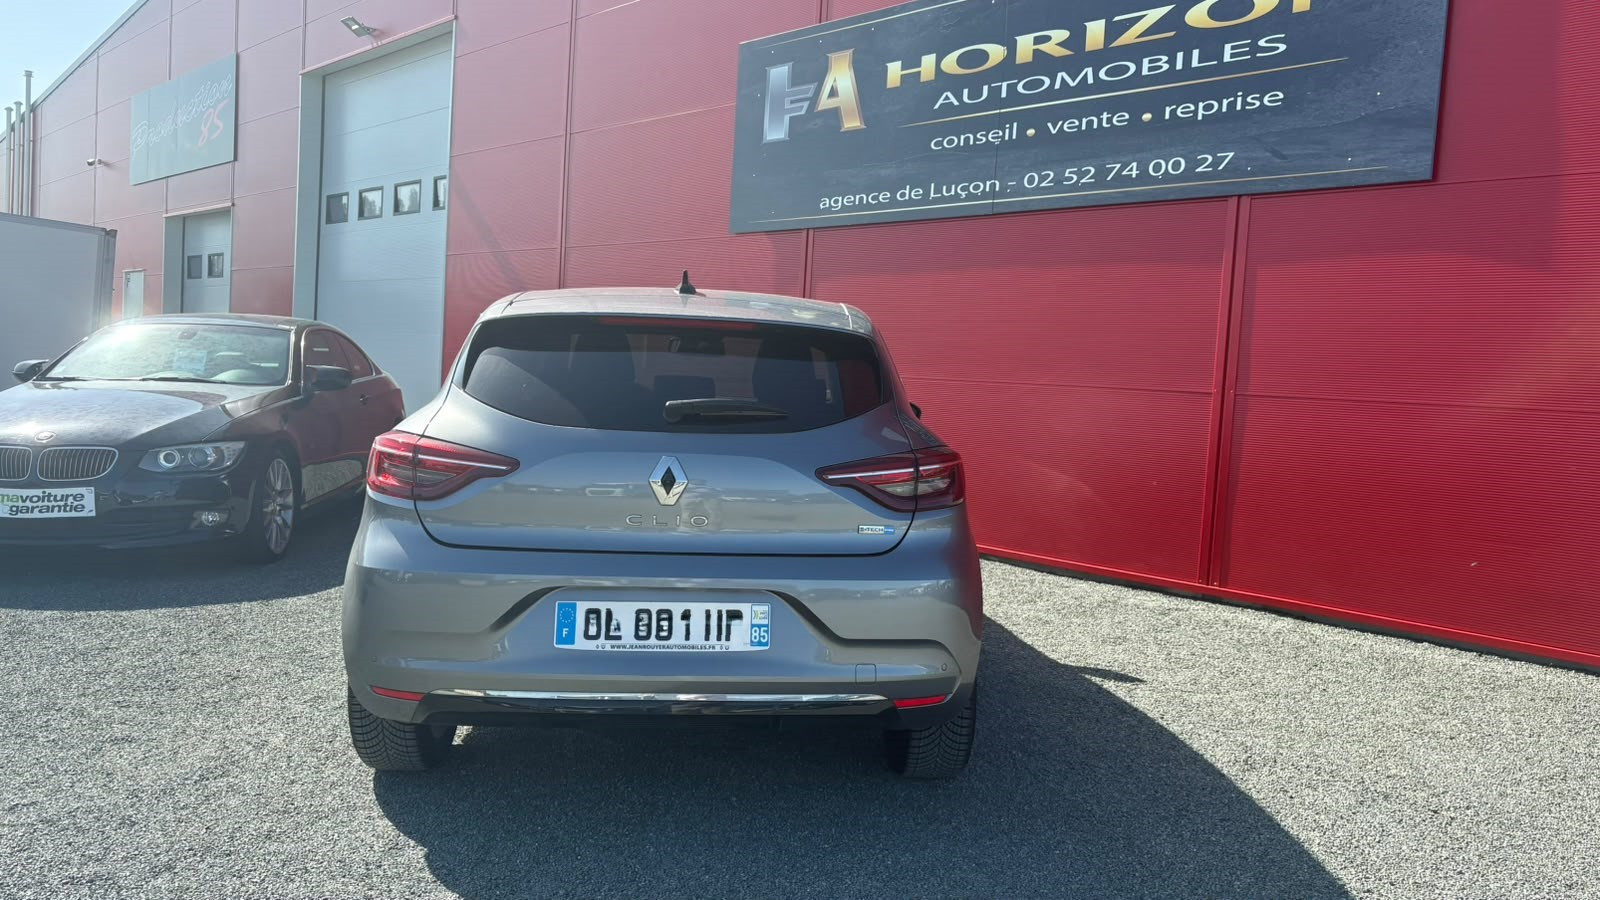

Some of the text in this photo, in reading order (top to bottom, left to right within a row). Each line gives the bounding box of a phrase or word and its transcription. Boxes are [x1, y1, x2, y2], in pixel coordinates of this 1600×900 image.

[933, 34, 1287, 109] AUTOMOBILES
[197, 98, 230, 148] 85
[930, 90, 1284, 151] conseil vente reprise
[819, 192, 890, 211] agence
[896, 185, 923, 201] de
[930, 178, 1000, 200] Luçon
[1023, 171, 1055, 188] 02
[1062, 166, 1096, 185] 52
[1105, 163, 1139, 181] 74
[1148, 157, 1186, 177] 00
[1195, 152, 1235, 172] 27
[9, 502, 85, 516] garantie
[625, 514, 710, 528] CLIO
[562, 629, 569, 638] F
[751, 626, 768, 643] 85
